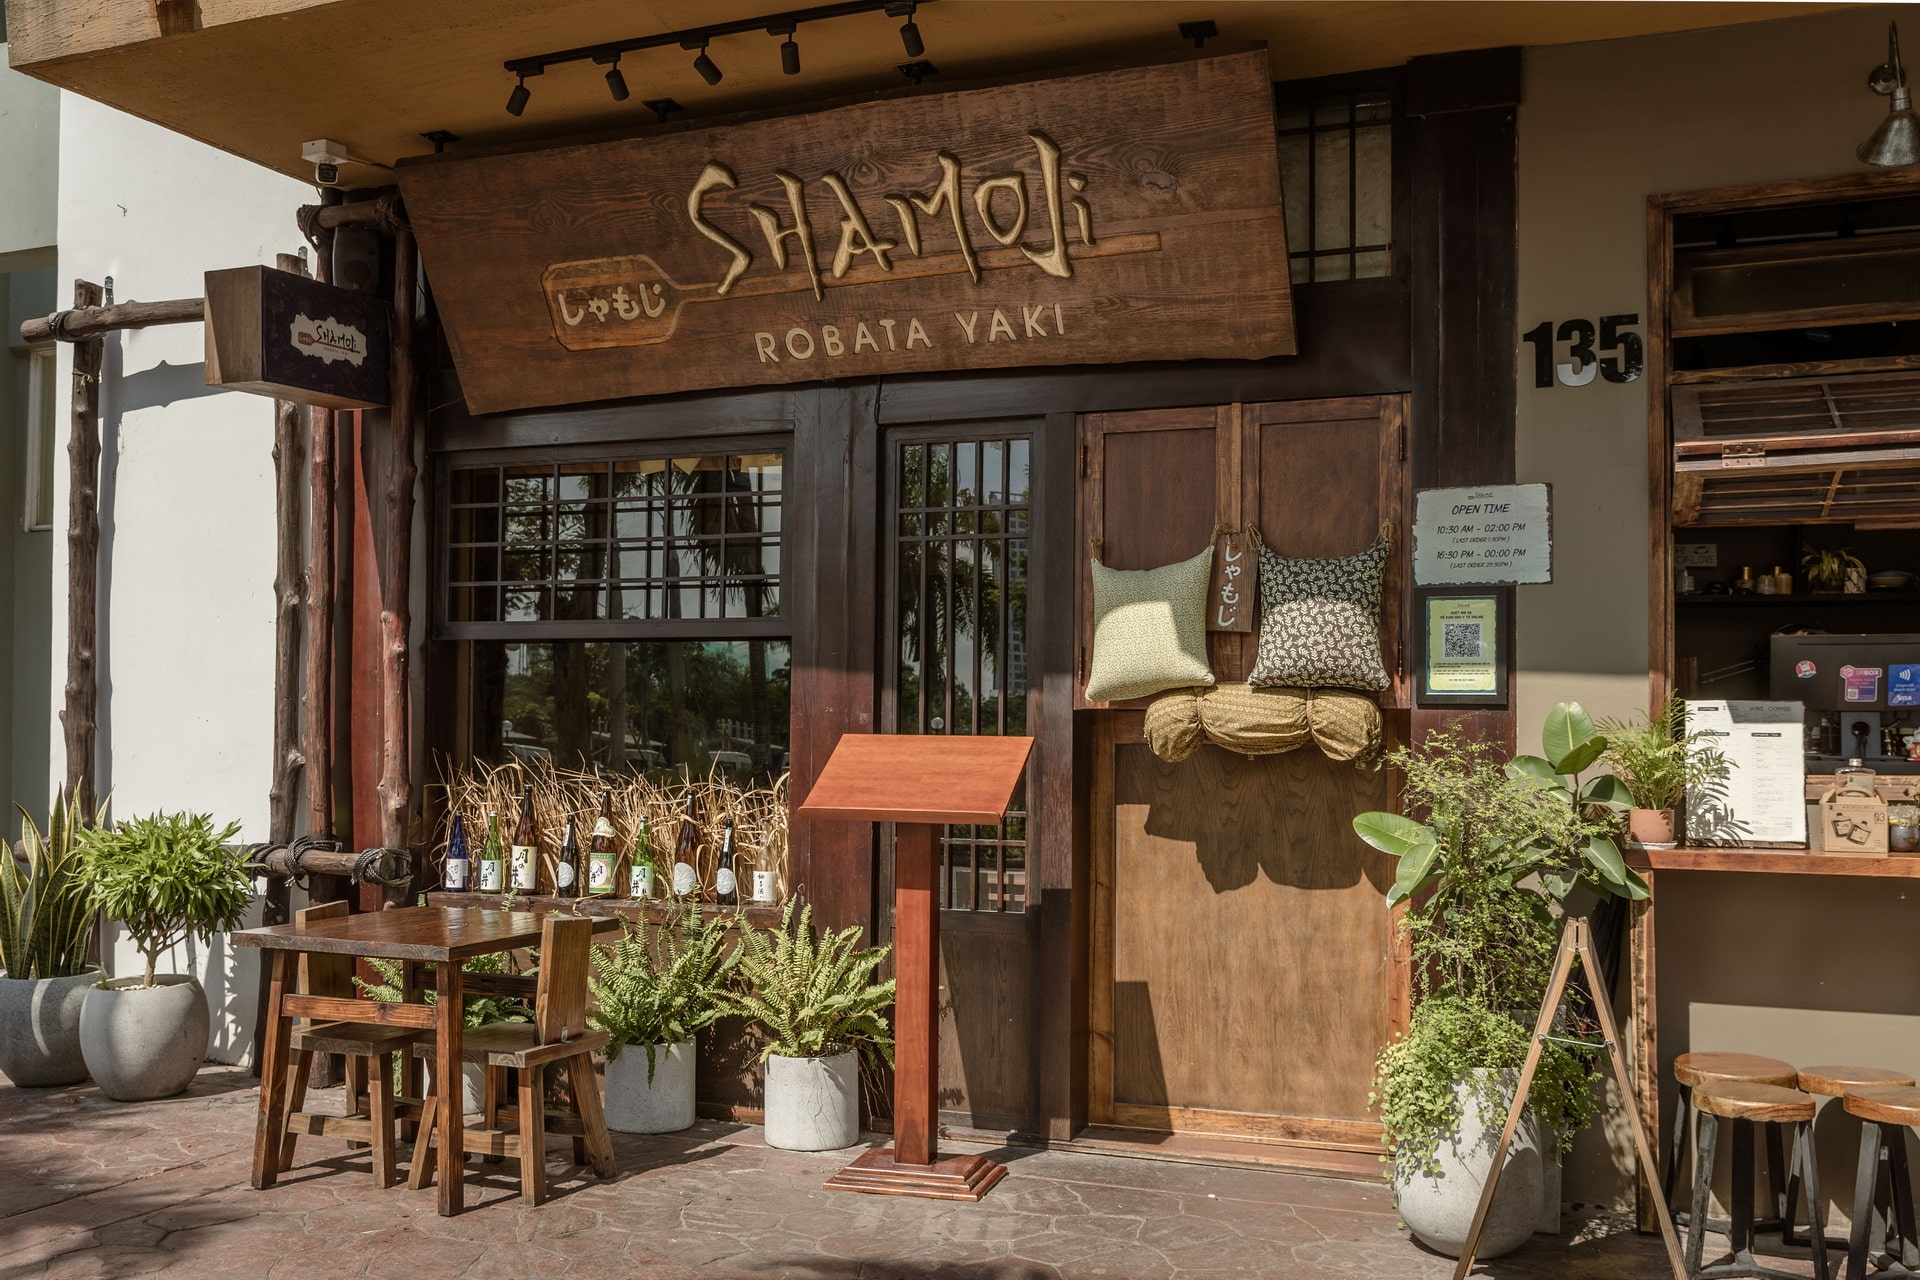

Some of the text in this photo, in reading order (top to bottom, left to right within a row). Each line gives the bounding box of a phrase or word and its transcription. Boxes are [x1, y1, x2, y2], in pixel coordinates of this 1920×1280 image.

[556, 282, 667, 328] しゃもじ
[754, 302, 1065, 364] ROBATA YAKI
[1522, 313, 1644, 389] 135
[1437, 525, 1459, 534] 10:30
[1461, 525, 1474, 533] AM
[1484, 524, 1510, 532] 02:00
[1512, 523, 1526, 531] PM
[1451, 503, 1511, 515] OPEN TIME
[1436, 550, 1459, 559] 16:30
[1461, 550, 1474, 558] PM
[1484, 549, 1511, 557] 00:00
[1512, 548, 1526, 557] PM
[1217, 544, 1243, 627] しゃもじ
